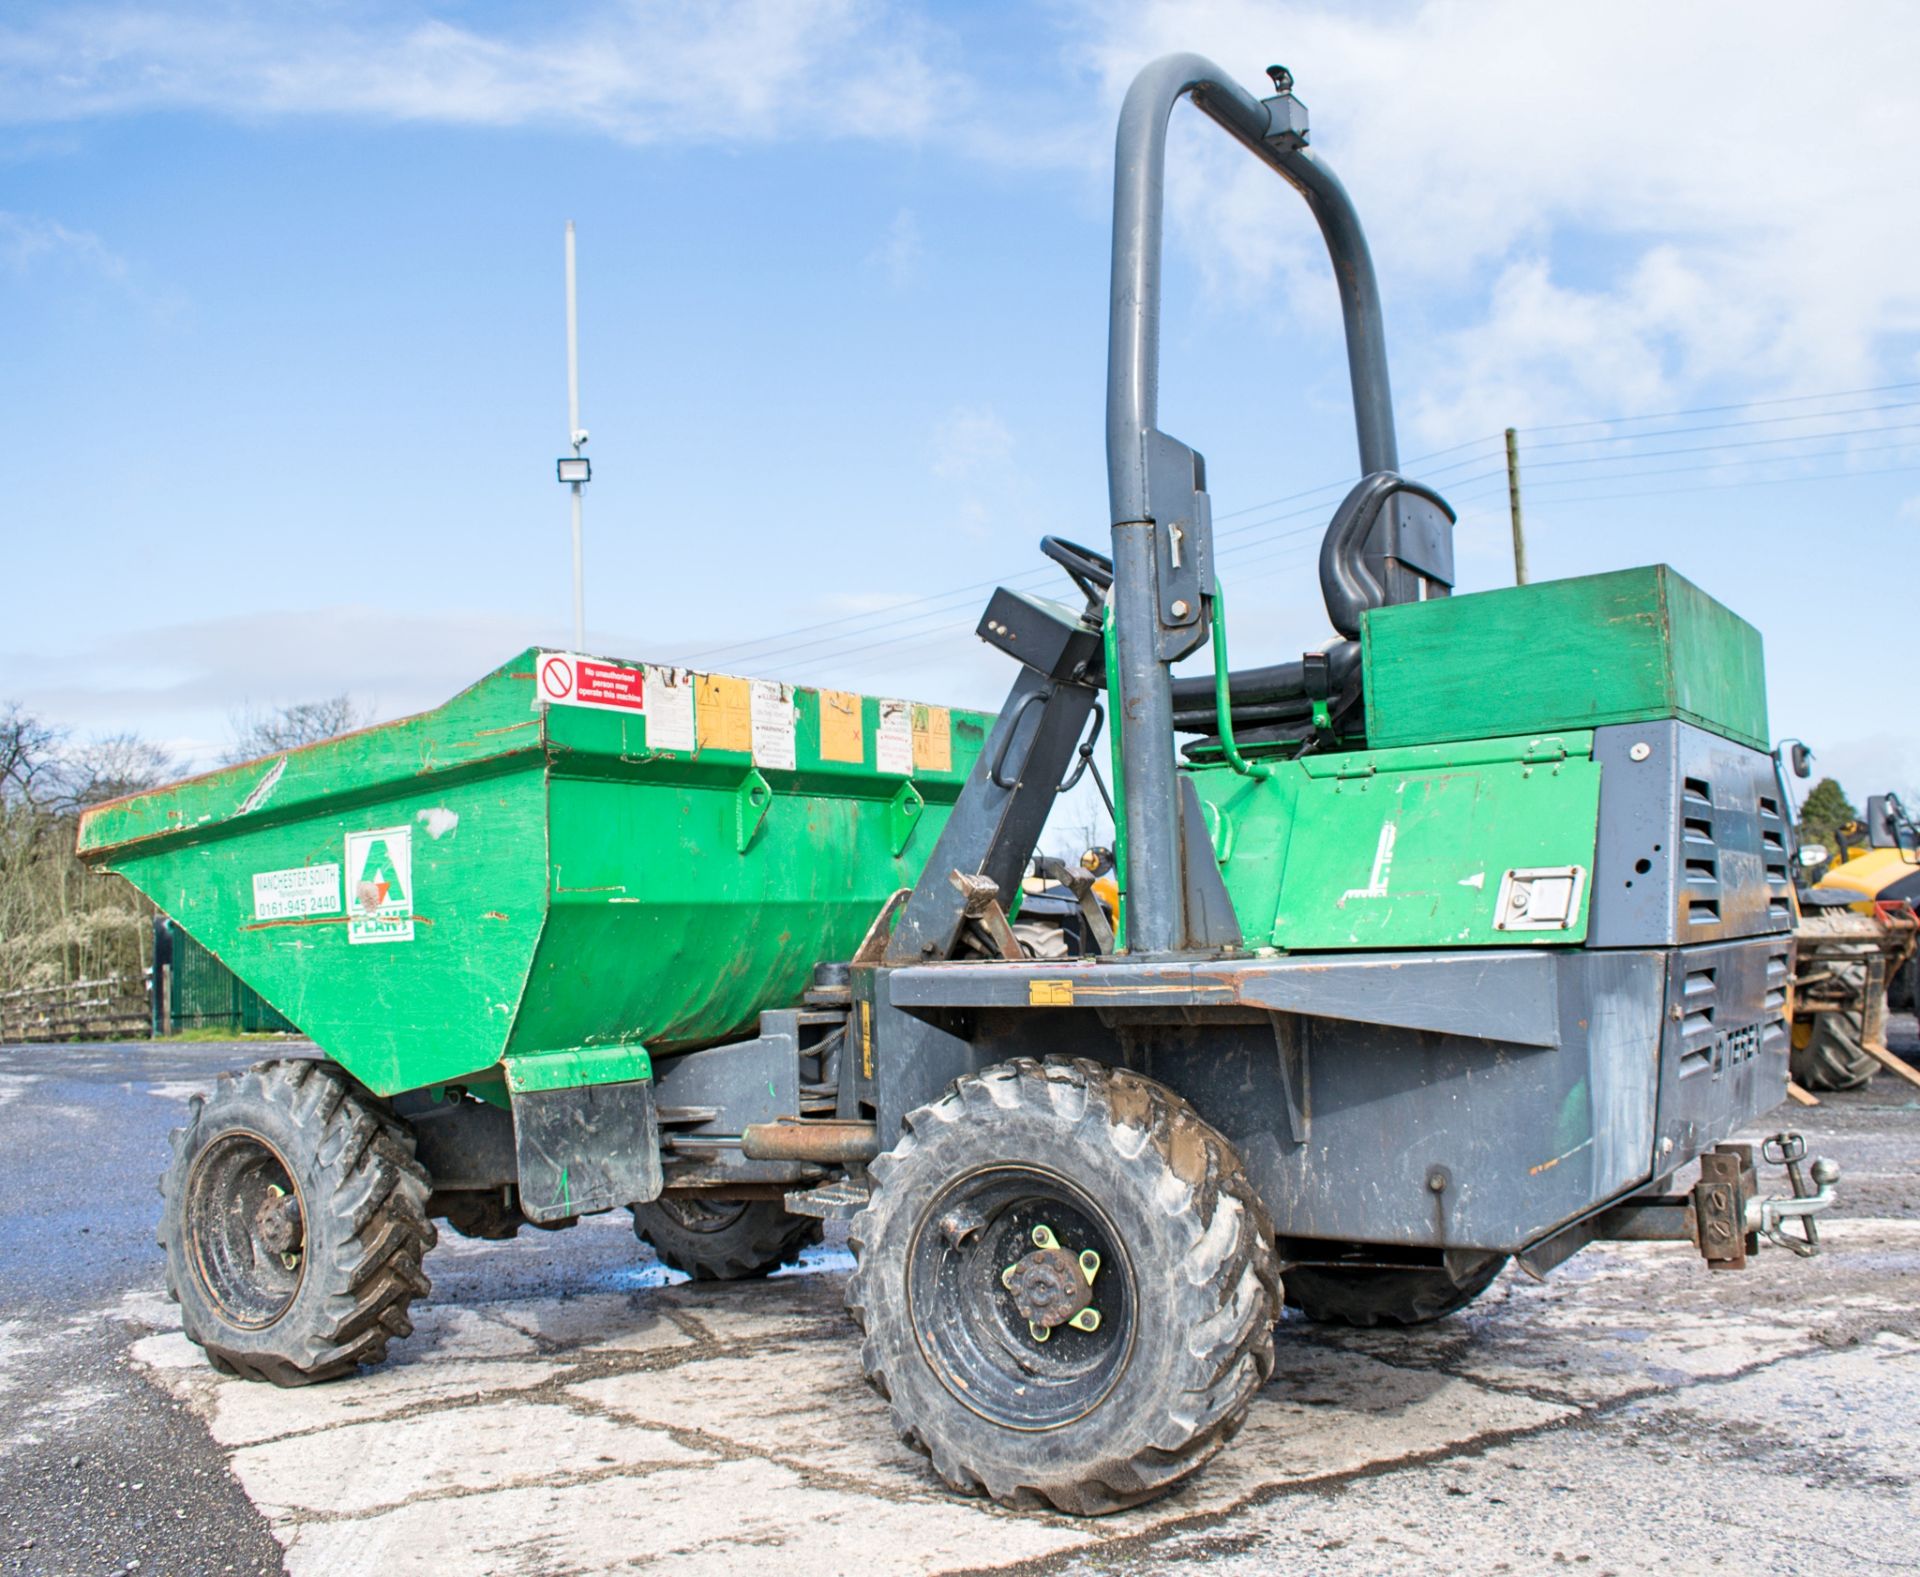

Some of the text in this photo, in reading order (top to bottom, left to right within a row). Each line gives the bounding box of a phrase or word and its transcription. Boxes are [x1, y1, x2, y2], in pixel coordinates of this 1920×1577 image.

[592, 680, 628, 692] person may
[578, 688, 641, 702] operate this machine
[256, 867, 336, 891] MANCHESTER SOUTH
[258, 895, 337, 916] 0161-945 2440
